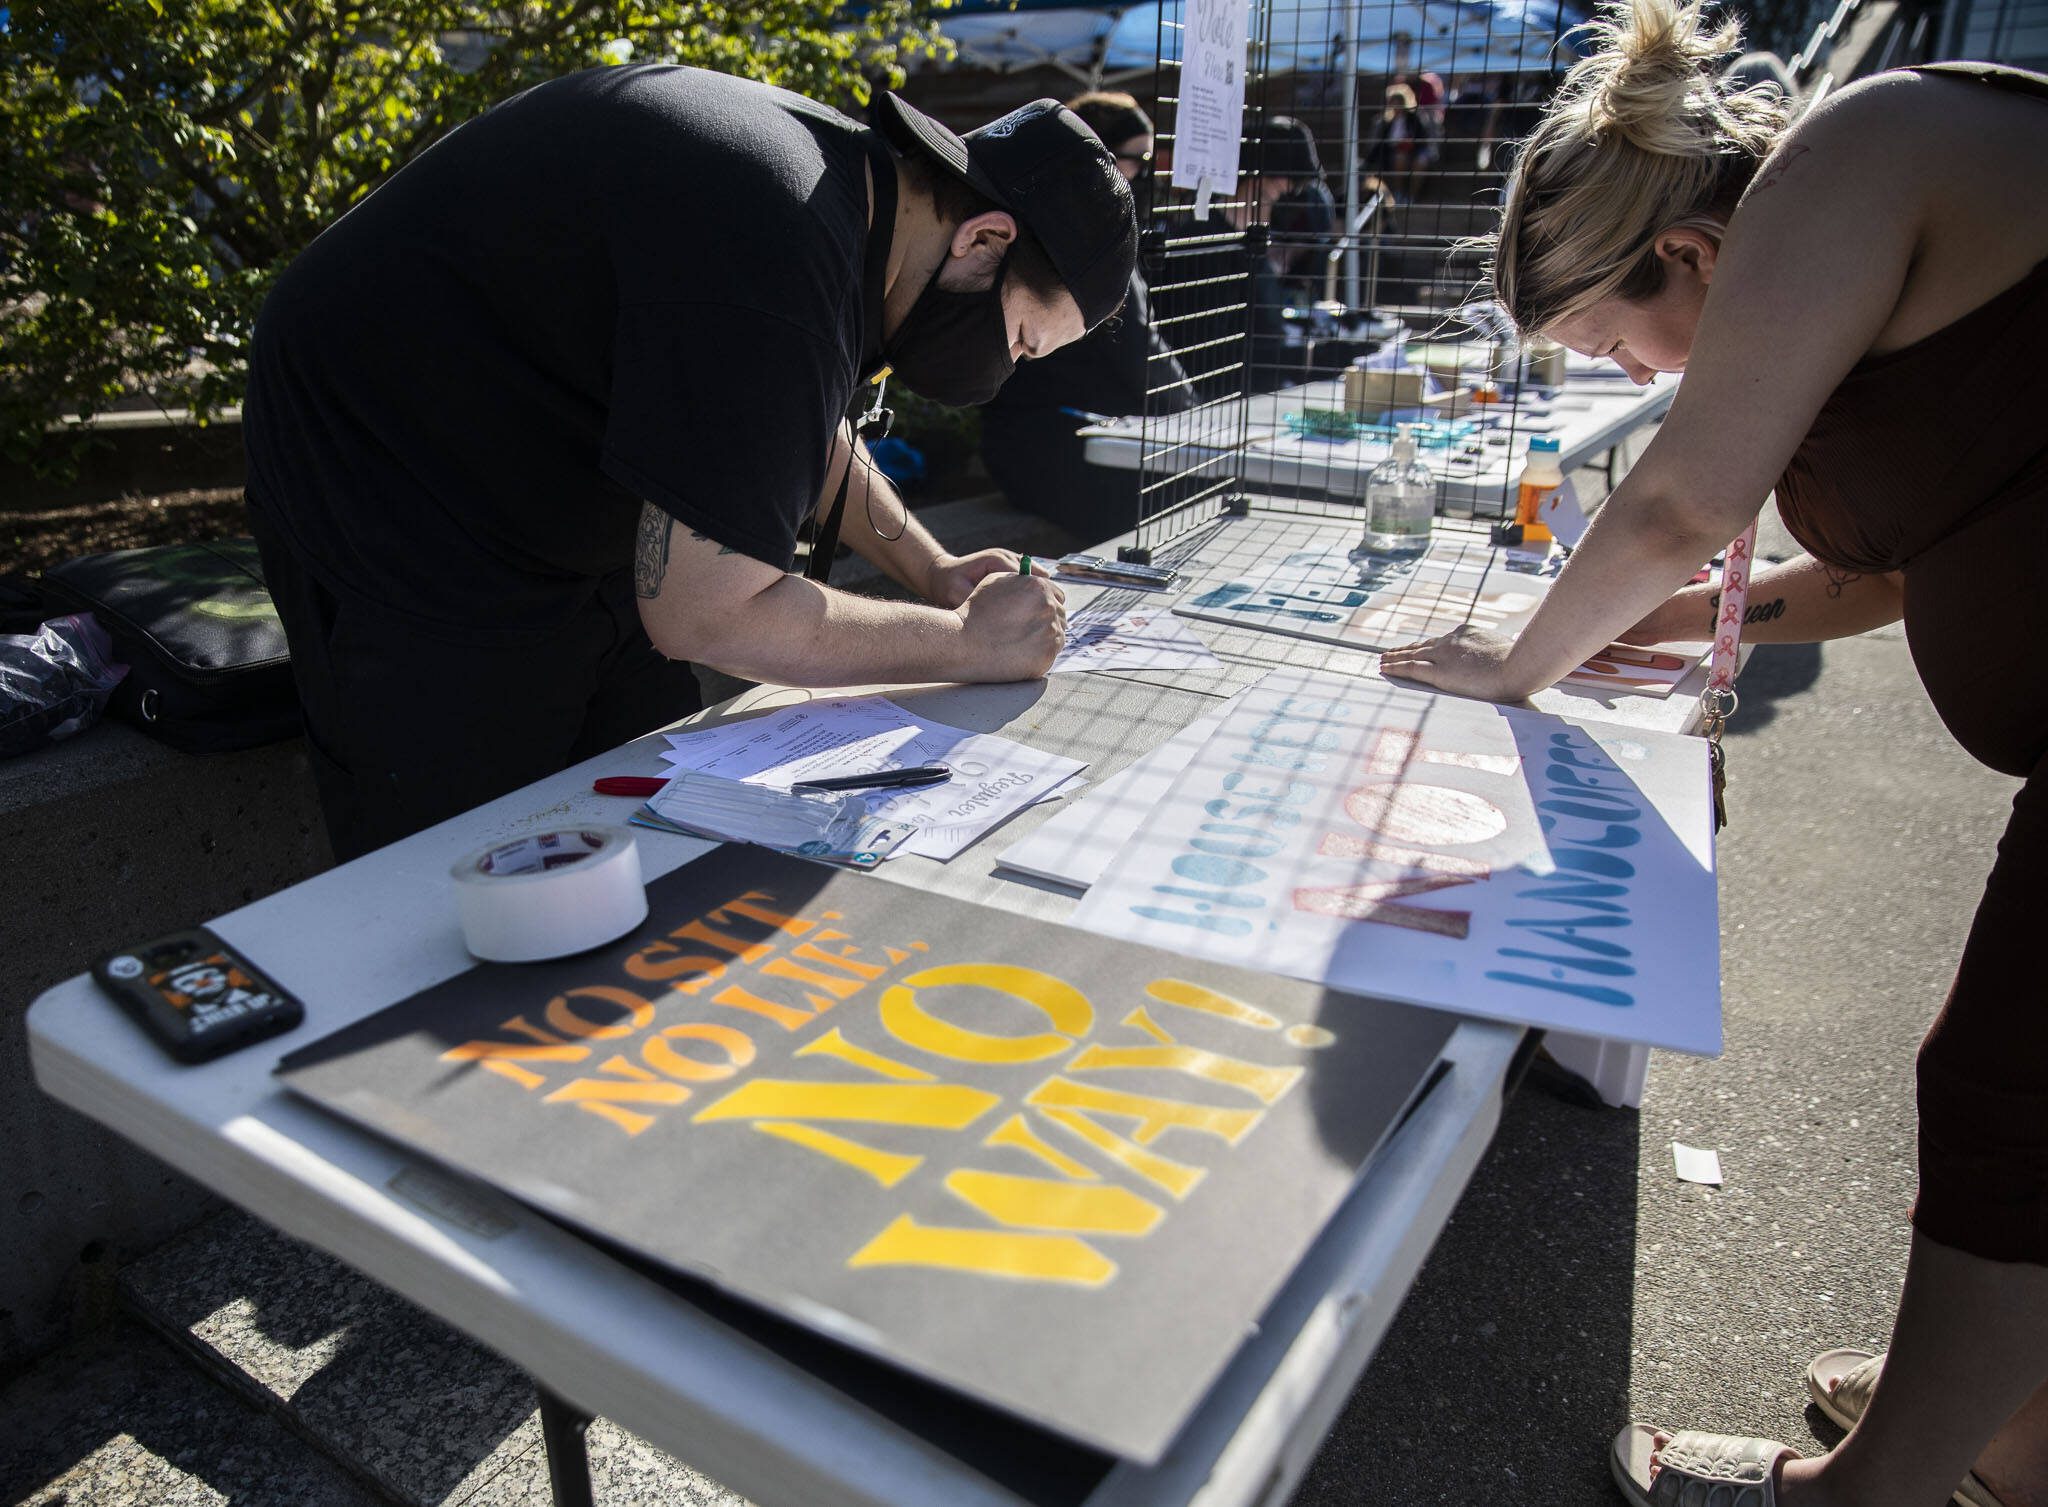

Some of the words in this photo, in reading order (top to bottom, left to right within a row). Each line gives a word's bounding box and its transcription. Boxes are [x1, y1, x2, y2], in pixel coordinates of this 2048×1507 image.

[948, 771, 1034, 818] Register
[1128, 771, 1319, 938] HOUSE
[1230, 698, 1352, 773] KEYS
[1291, 725, 1526, 940] NOT
[439, 985, 655, 1090] NO
[541, 1022, 757, 1137] NO
[690, 961, 1095, 1188] NO
[847, 976, 1336, 1289] WAY!
